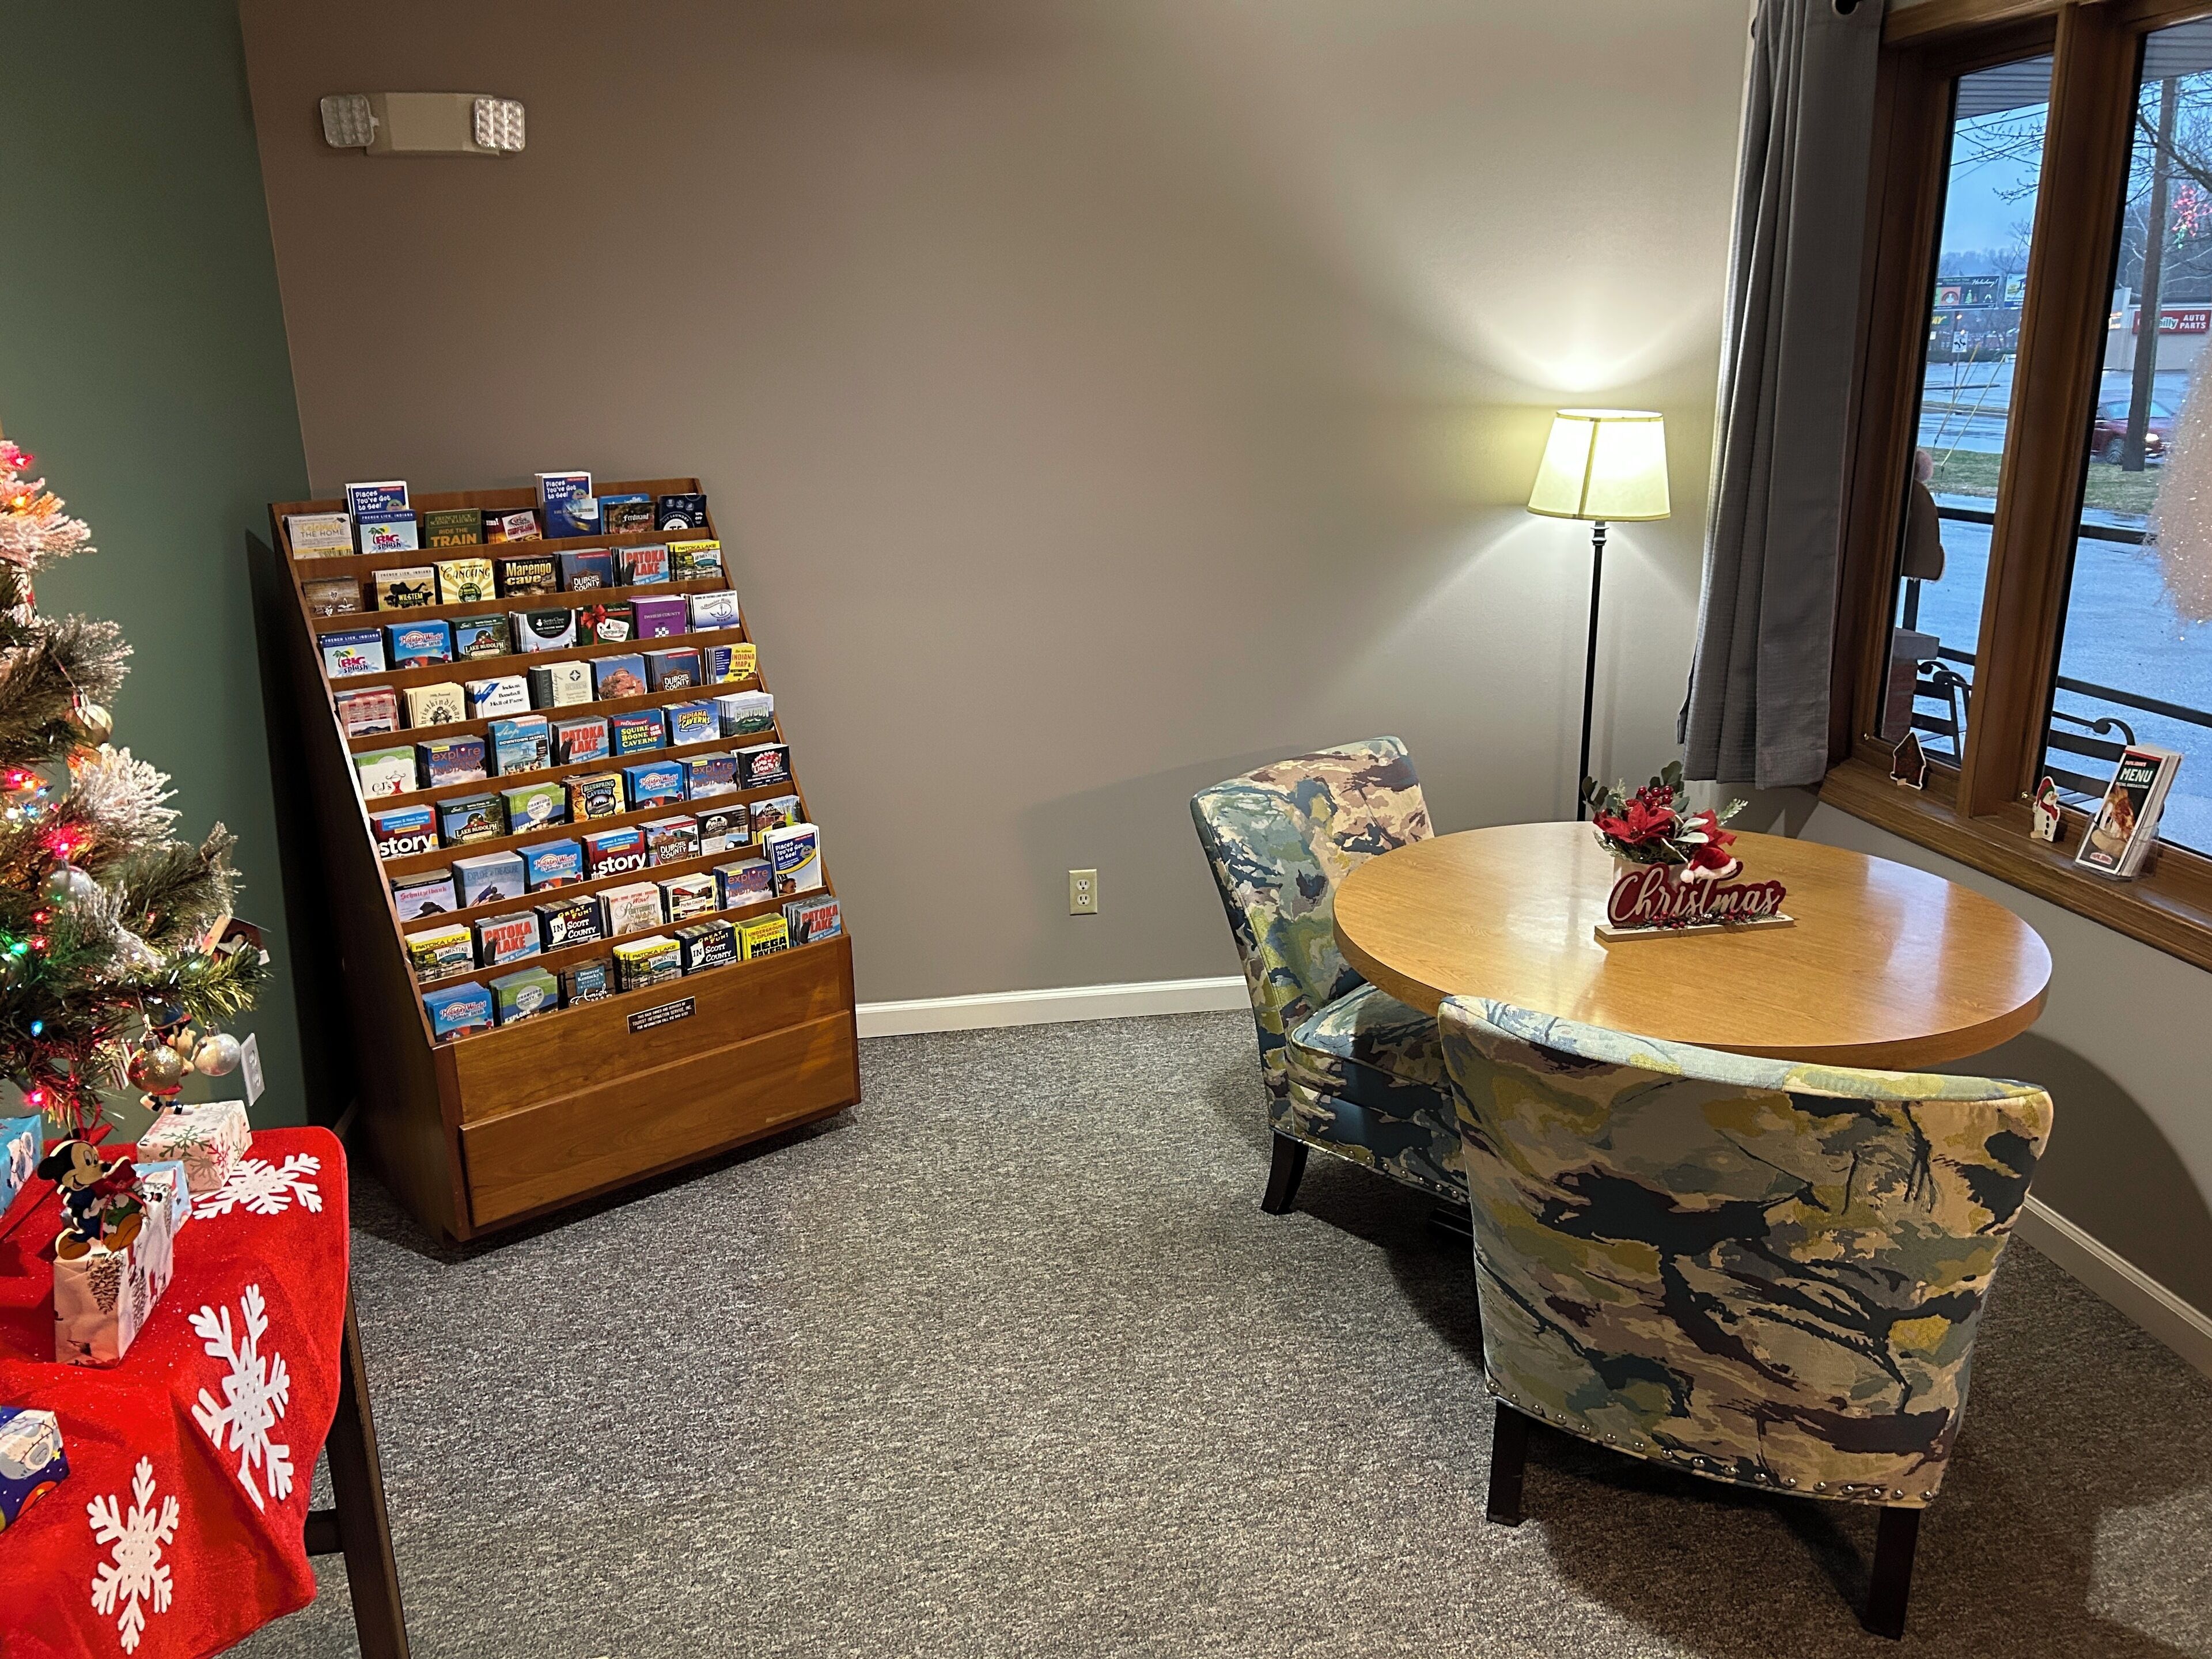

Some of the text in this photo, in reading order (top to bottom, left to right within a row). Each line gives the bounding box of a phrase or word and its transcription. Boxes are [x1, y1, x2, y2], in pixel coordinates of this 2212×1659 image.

[1972, 278, 1998, 287] Holiday!
[355, 490, 377, 498] Places
[357, 497, 377, 505] You've
[623, 513, 649, 522] Ferdinand
[376, 535, 399, 544] BIG
[378, 541, 401, 550] splash
[430, 533, 477, 547] TRAIN
[626, 550, 665, 564] PATOKA
[440, 565, 490, 580] CANOEING
[506, 562, 552, 577] Marengo
[635, 562, 660, 576] LAKE
[506, 575, 541, 585] cave
[574, 575, 599, 586] DUBOIS
[574, 581, 600, 592] COUNTY
[717, 614, 733, 622] MARINA
[400, 636, 424, 645] Holiday
[465, 645, 479, 653] LAKE
[341, 657, 365, 668] BIG
[344, 664, 368, 673] splash
[664, 674, 689, 685] DUBOIS
[665, 679, 690, 691] COUNTY
[498, 690, 521, 698] Baseball
[679, 711, 707, 723] INDIANA
[734, 706, 769, 722] CORYDON
[681, 716, 711, 729] CAVERNS
[497, 726, 519, 738] Shop
[562, 725, 604, 743] PATOKA
[621, 725, 649, 735] SQUIRE
[499, 737, 529, 745] DOWNTOWN
[622, 732, 649, 741] BOONE
[622, 737, 657, 748] CAVERNS
[572, 738, 599, 755] LAKE
[432, 747, 480, 764] explore
[588, 750, 601, 758] Guide
[432, 760, 483, 775] INDIANA
[692, 762, 733, 775] explore
[752, 760, 767, 768] LAND
[754, 763, 774, 774] LIGHTS
[641, 777, 661, 786] Holiday
[2120, 768, 2153, 783] MENU
[372, 782, 392, 793] CJ's
[584, 781, 614, 792] BLUESPRING
[587, 789, 612, 799] CAVERNS
[528, 798, 550, 808] CRAWFORD
[456, 823, 497, 837] LAKE RUDOLPH
[380, 834, 437, 857] story
[660, 841, 686, 854] DUBOIS
[775, 842, 794, 851] Places
[776, 845, 793, 857] You've
[661, 846, 687, 859] COUNTY
[785, 850, 797, 859] See!
[536, 854, 576, 869] Holiday World
[598, 853, 646, 874] story
[728, 869, 768, 884] explore
[400, 887, 447, 901] Schnitzelbank
[729, 882, 770, 896] INDIANA
[1611, 866, 1780, 922] Christmas
[632, 895, 649, 904] Wow!
[681, 900, 692, 908] Parke
[557, 905, 585, 918] GREAT
[571, 907, 592, 919] FUN!
[802, 904, 838, 923] PATOKA
[553, 919, 590, 933] IN SCOTT
[748, 923, 786, 937] UNDERGROUND
[810, 916, 834, 934] LAKE
[484, 921, 532, 944] PATOKA
[567, 926, 596, 939] COUNTY
[698, 931, 722, 943] GREAT
[756, 930, 778, 940] ZIPLINES
[415, 935, 466, 949] PATOKA LAKE
[497, 935, 527, 955] LAKE
[710, 934, 729, 944] FUN!
[751, 936, 787, 953] MEGA
[438, 946, 468, 957] HOMESTEAD
[516, 948, 530, 956] Guide
[632, 944, 676, 959] PATOKA LAKE
[693, 943, 726, 957] IN SCOTT
[706, 950, 732, 962] COUNTY
[751, 944, 787, 959] CAVERN
[652, 955, 678, 965] HOMESTEAD
[578, 972, 603, 982] Kentucky's
[579, 969, 600, 977] Discover
[518, 988, 542, 999] CRAWFORD
[570, 983, 608, 1005] Amish
[442, 1001, 486, 1018] Holiday World
[647, 1012, 670, 1022] INFORMATION
[671, 1007, 685, 1015] SERVICE,
[505, 1009, 531, 1024] EXPLORE
[643, 1020, 661, 1028] INFORMATION
